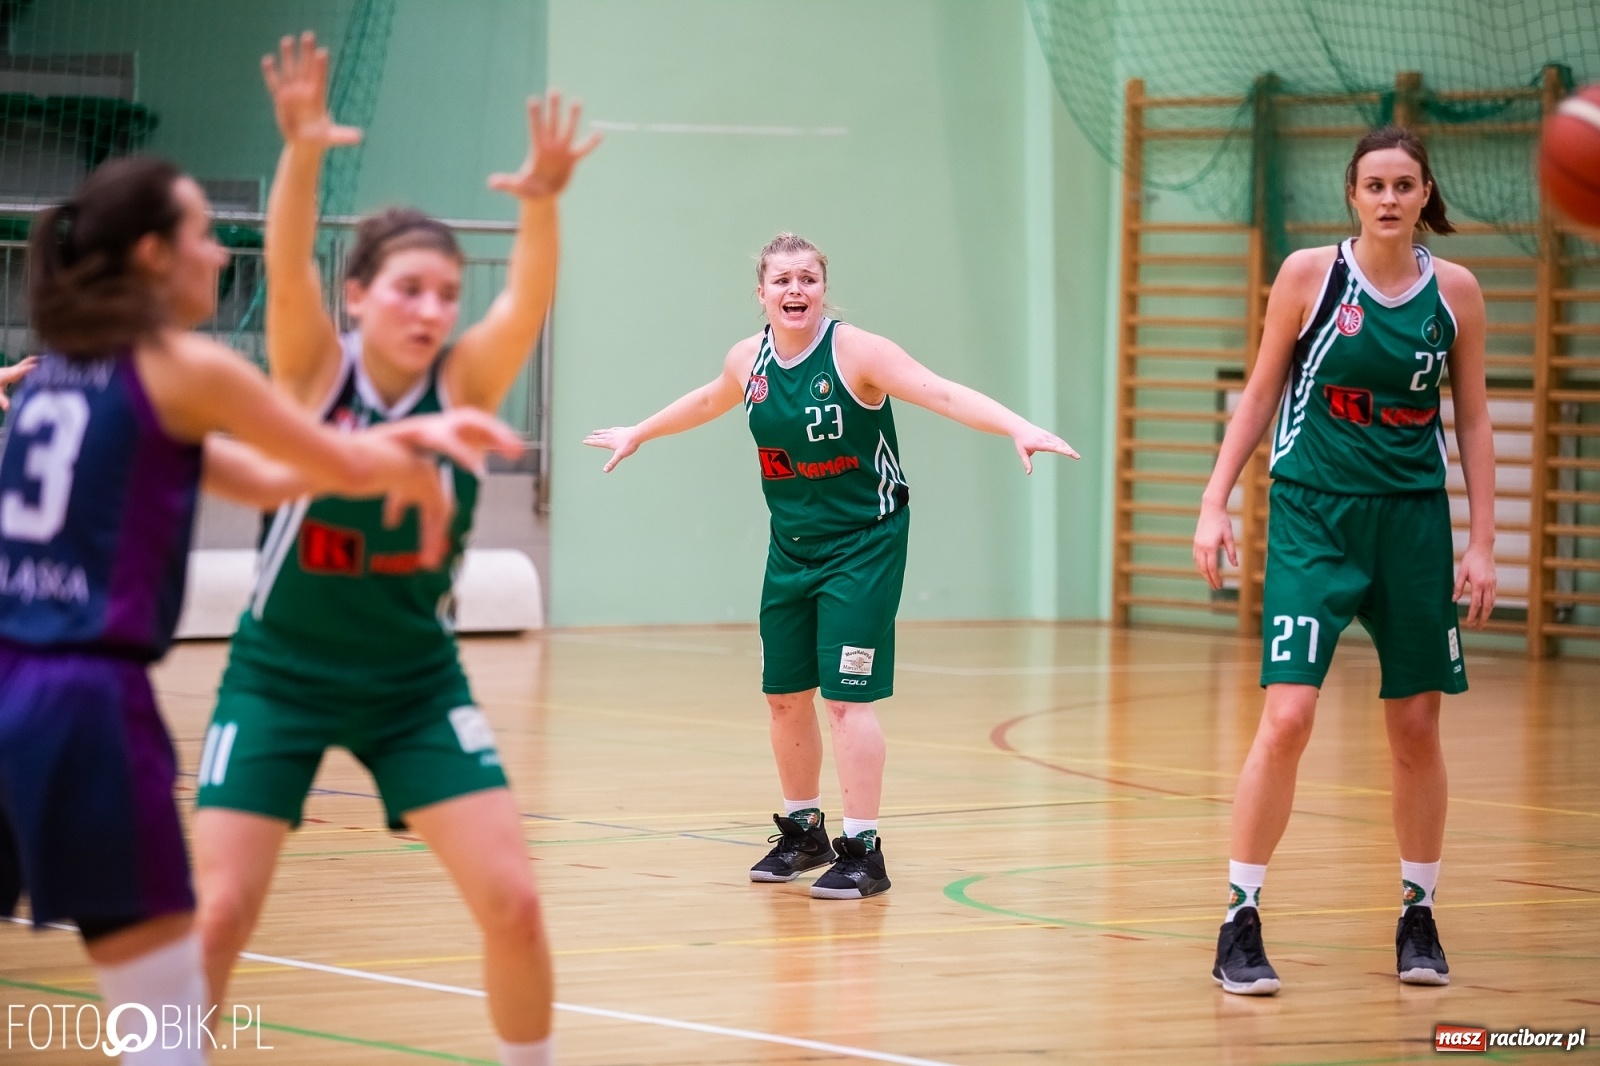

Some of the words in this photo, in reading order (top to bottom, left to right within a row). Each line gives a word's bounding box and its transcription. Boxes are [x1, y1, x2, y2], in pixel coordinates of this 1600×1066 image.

[1409, 351, 1447, 391] 27
[804, 403, 844, 442] 23
[1, 388, 90, 545] 3
[759, 451, 791, 476] K
[796, 456, 860, 479] KAMAN
[1271, 615, 1319, 664] 27
[199, 721, 238, 788] 11
